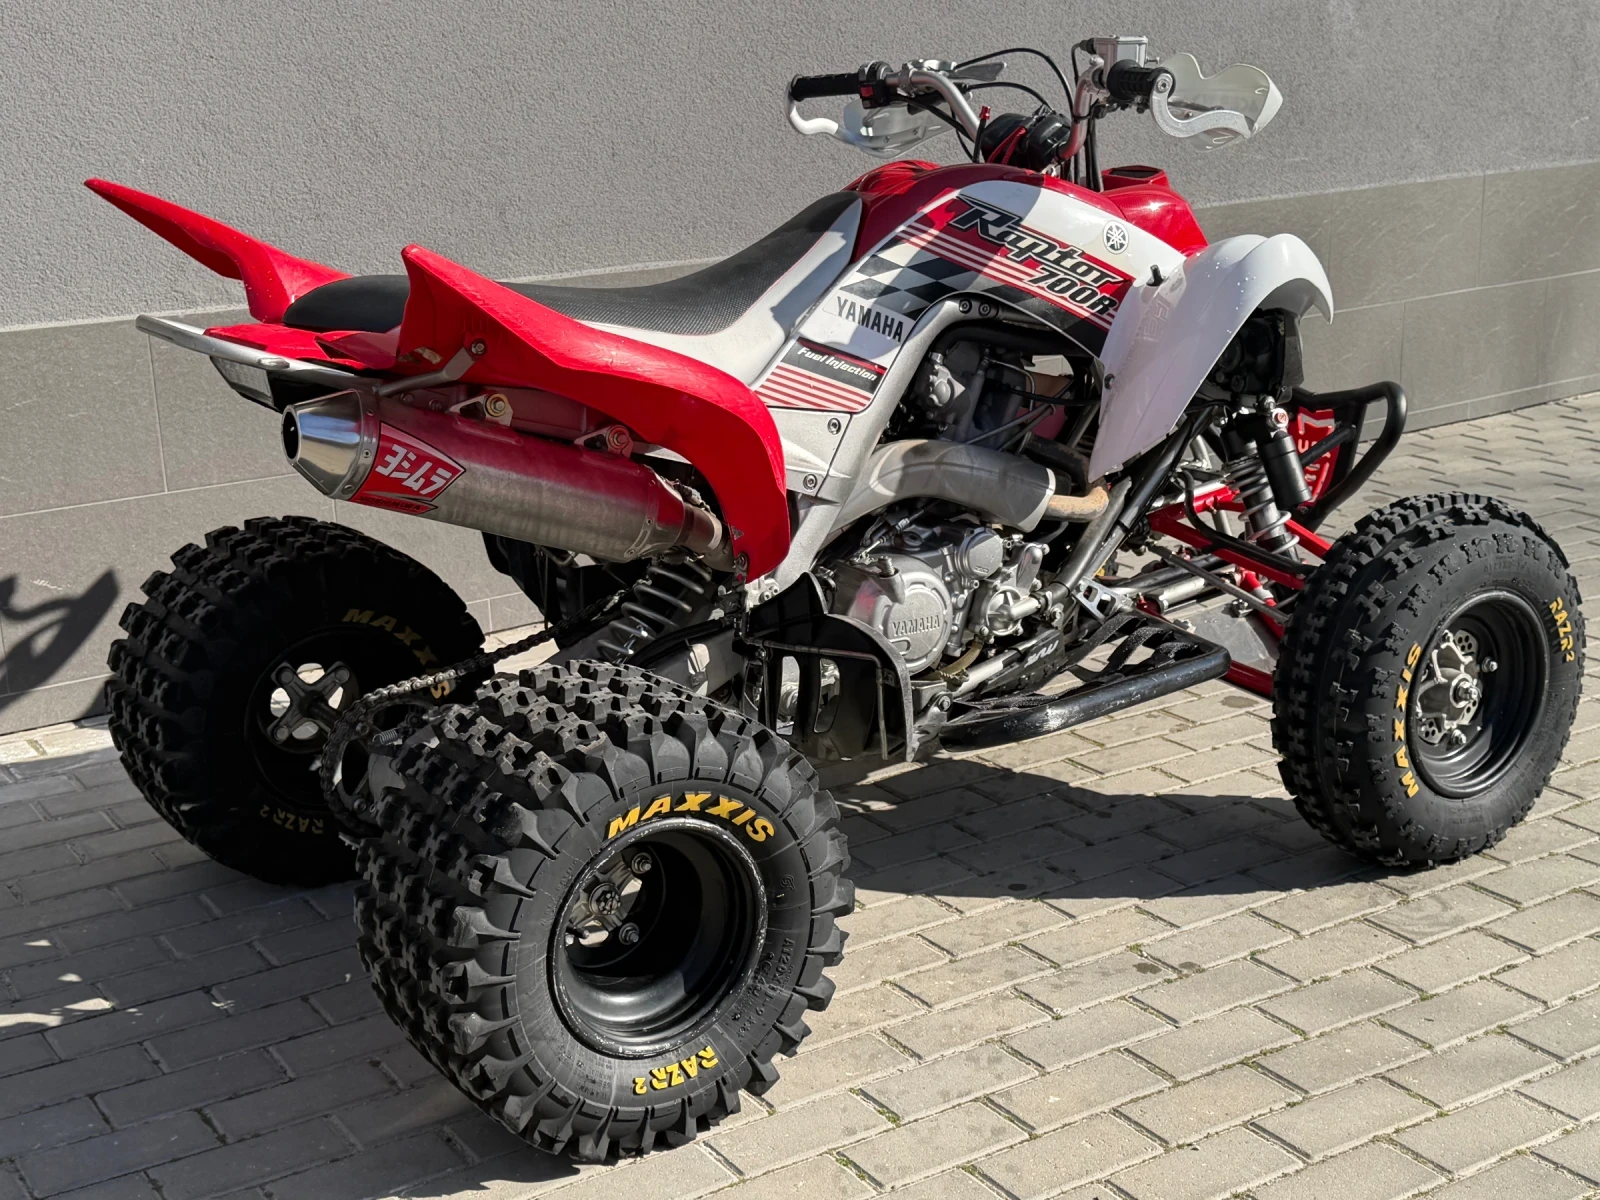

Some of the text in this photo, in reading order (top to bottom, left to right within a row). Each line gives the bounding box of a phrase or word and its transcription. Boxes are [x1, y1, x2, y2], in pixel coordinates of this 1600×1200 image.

[949, 194, 1128, 286] Raptor
[1022, 263, 1118, 316] 700R
[836, 296, 904, 342] YAMAHA
[797, 347, 878, 381] Fuel Injection
[375, 443, 453, 495] ヨシムラ
[892, 614, 940, 637] YAMAHA
[1394, 641, 1422, 798] MAXXIS
[607, 791, 775, 842] MAXXIS
